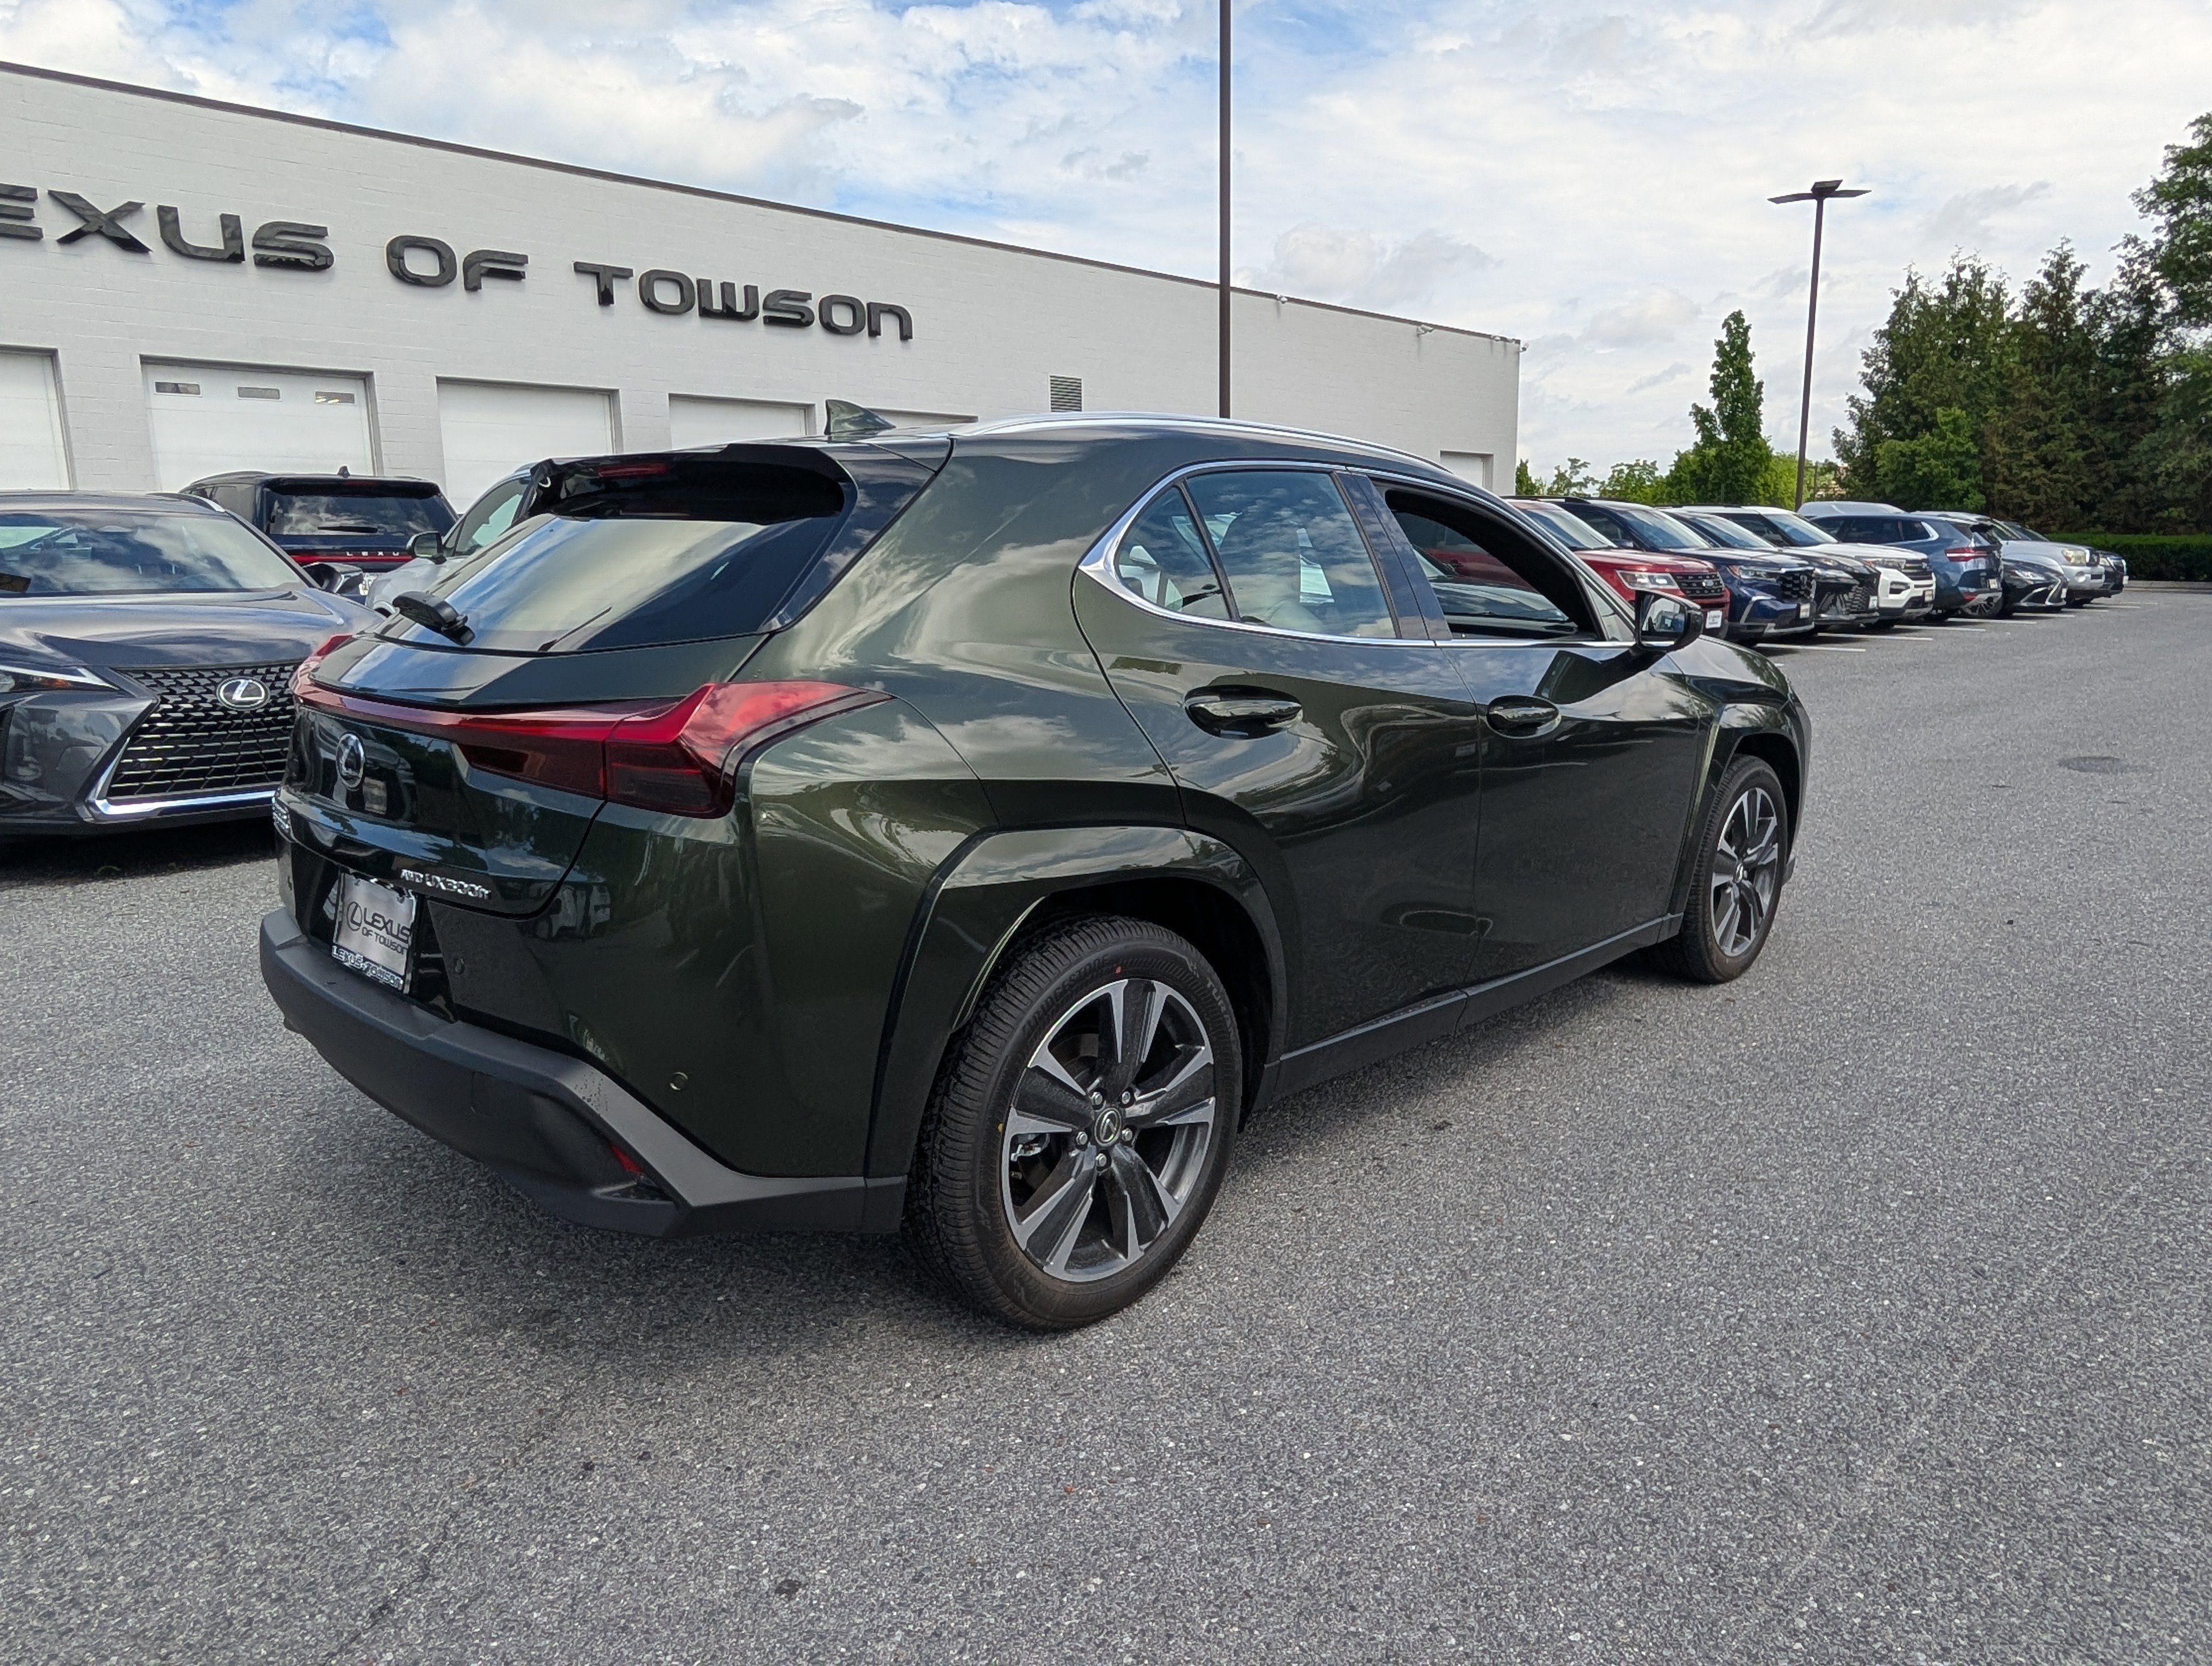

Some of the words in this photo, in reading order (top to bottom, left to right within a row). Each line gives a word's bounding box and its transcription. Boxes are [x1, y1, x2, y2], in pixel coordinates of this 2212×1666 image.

[385, 234, 529, 291] OF
[362, 926, 374, 938] OF
[364, 907, 411, 944] LEXUS
